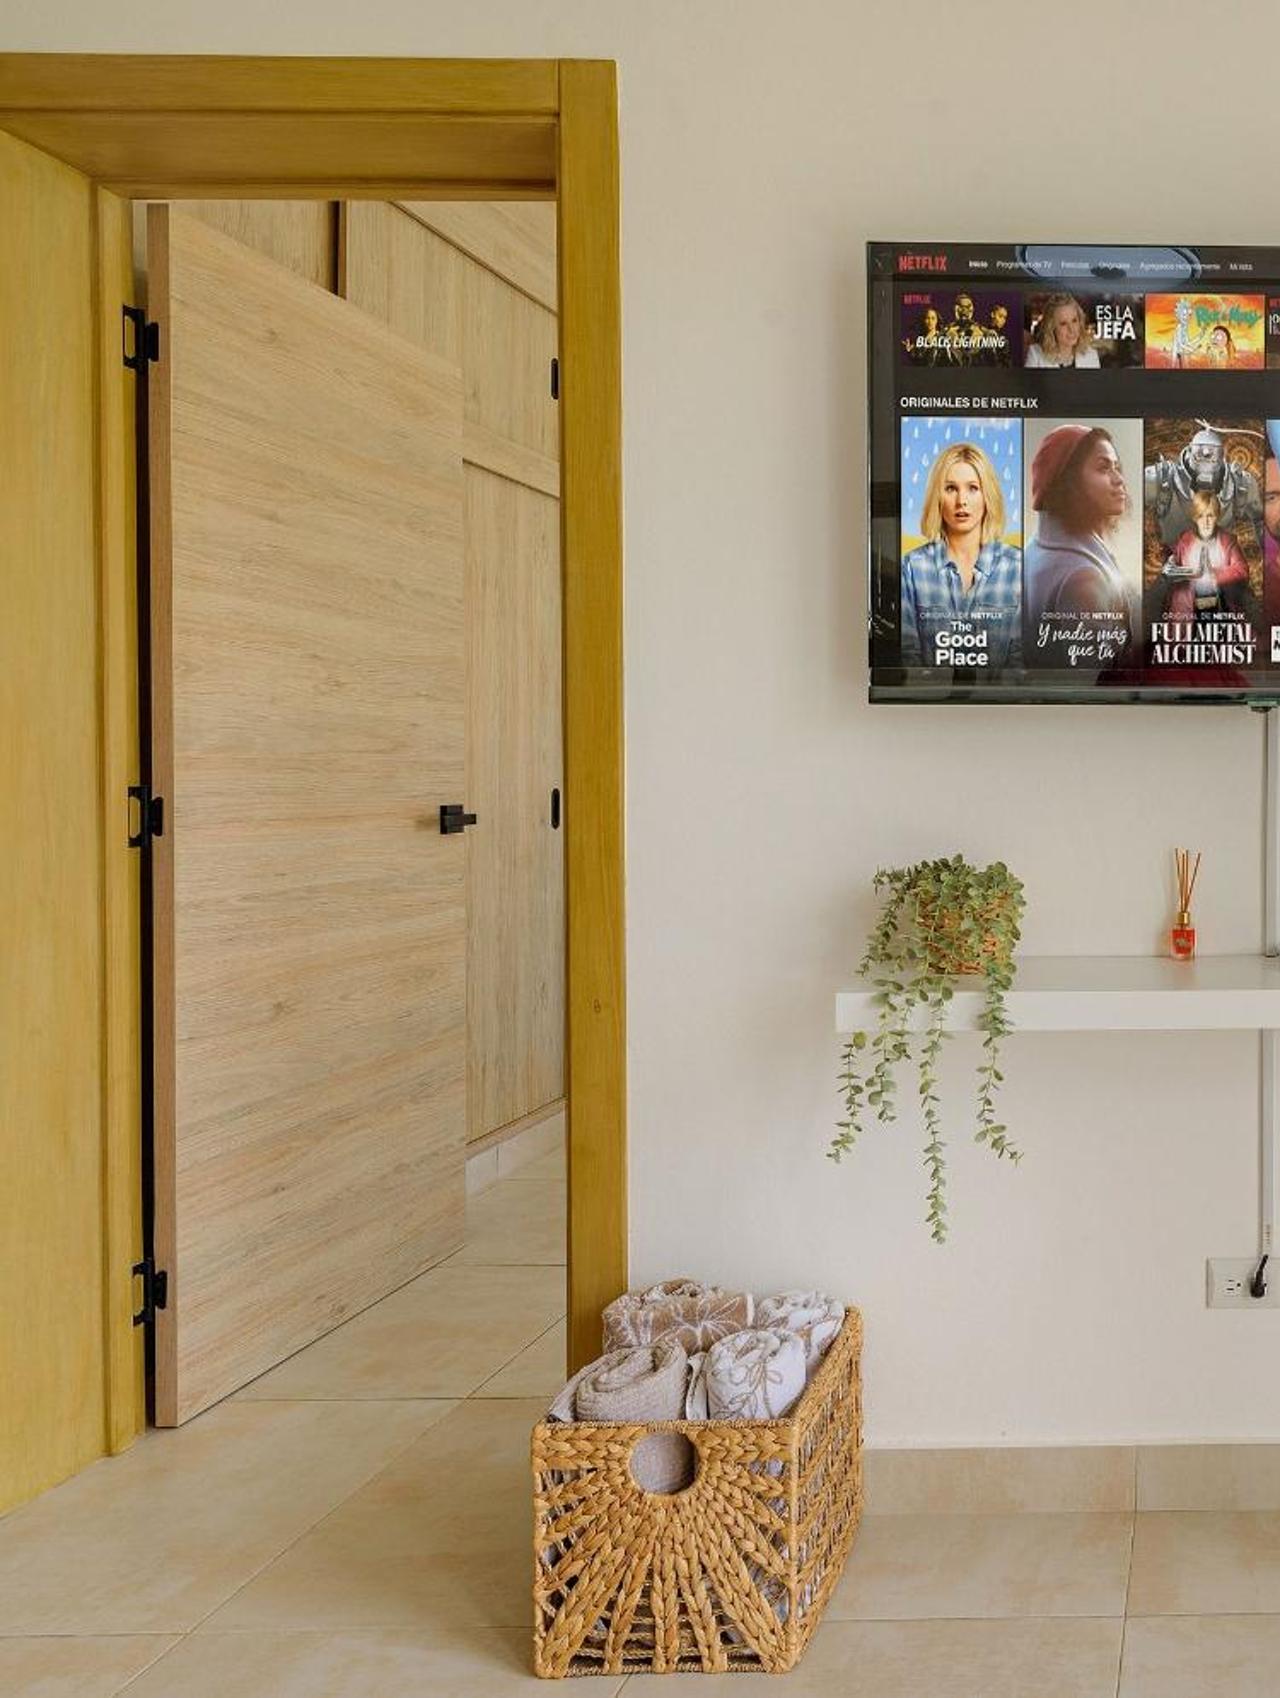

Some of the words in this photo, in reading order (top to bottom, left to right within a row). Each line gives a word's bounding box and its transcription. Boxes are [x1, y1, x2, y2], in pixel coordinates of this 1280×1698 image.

[898, 255, 947, 271] NETFLIX
[1096, 305, 1112, 320] ES
[1115, 305, 1134, 320] LA
[1093, 320, 1136, 340] JEFA
[915, 335, 951, 348] BLACK
[952, 335, 1006, 348] LIGHTNING
[900, 396, 970, 408] ORIGINALES
[972, 397, 989, 408] DE
[991, 397, 1039, 409] NETFLIX
[1092, 612, 1124, 620] NETFLIX
[1213, 612, 1245, 620] NETFLIX
[950, 621, 972, 631] The
[1037, 623, 1050, 647] Y
[1052, 621, 1096, 642] nadie
[1096, 625, 1128, 645] más
[1151, 622, 1257, 642] FULLMETAL
[935, 630, 988, 647] Good
[935, 648, 988, 666] Place
[1068, 644, 1096, 666] que
[1151, 643, 1257, 664] ALCHEMIST
